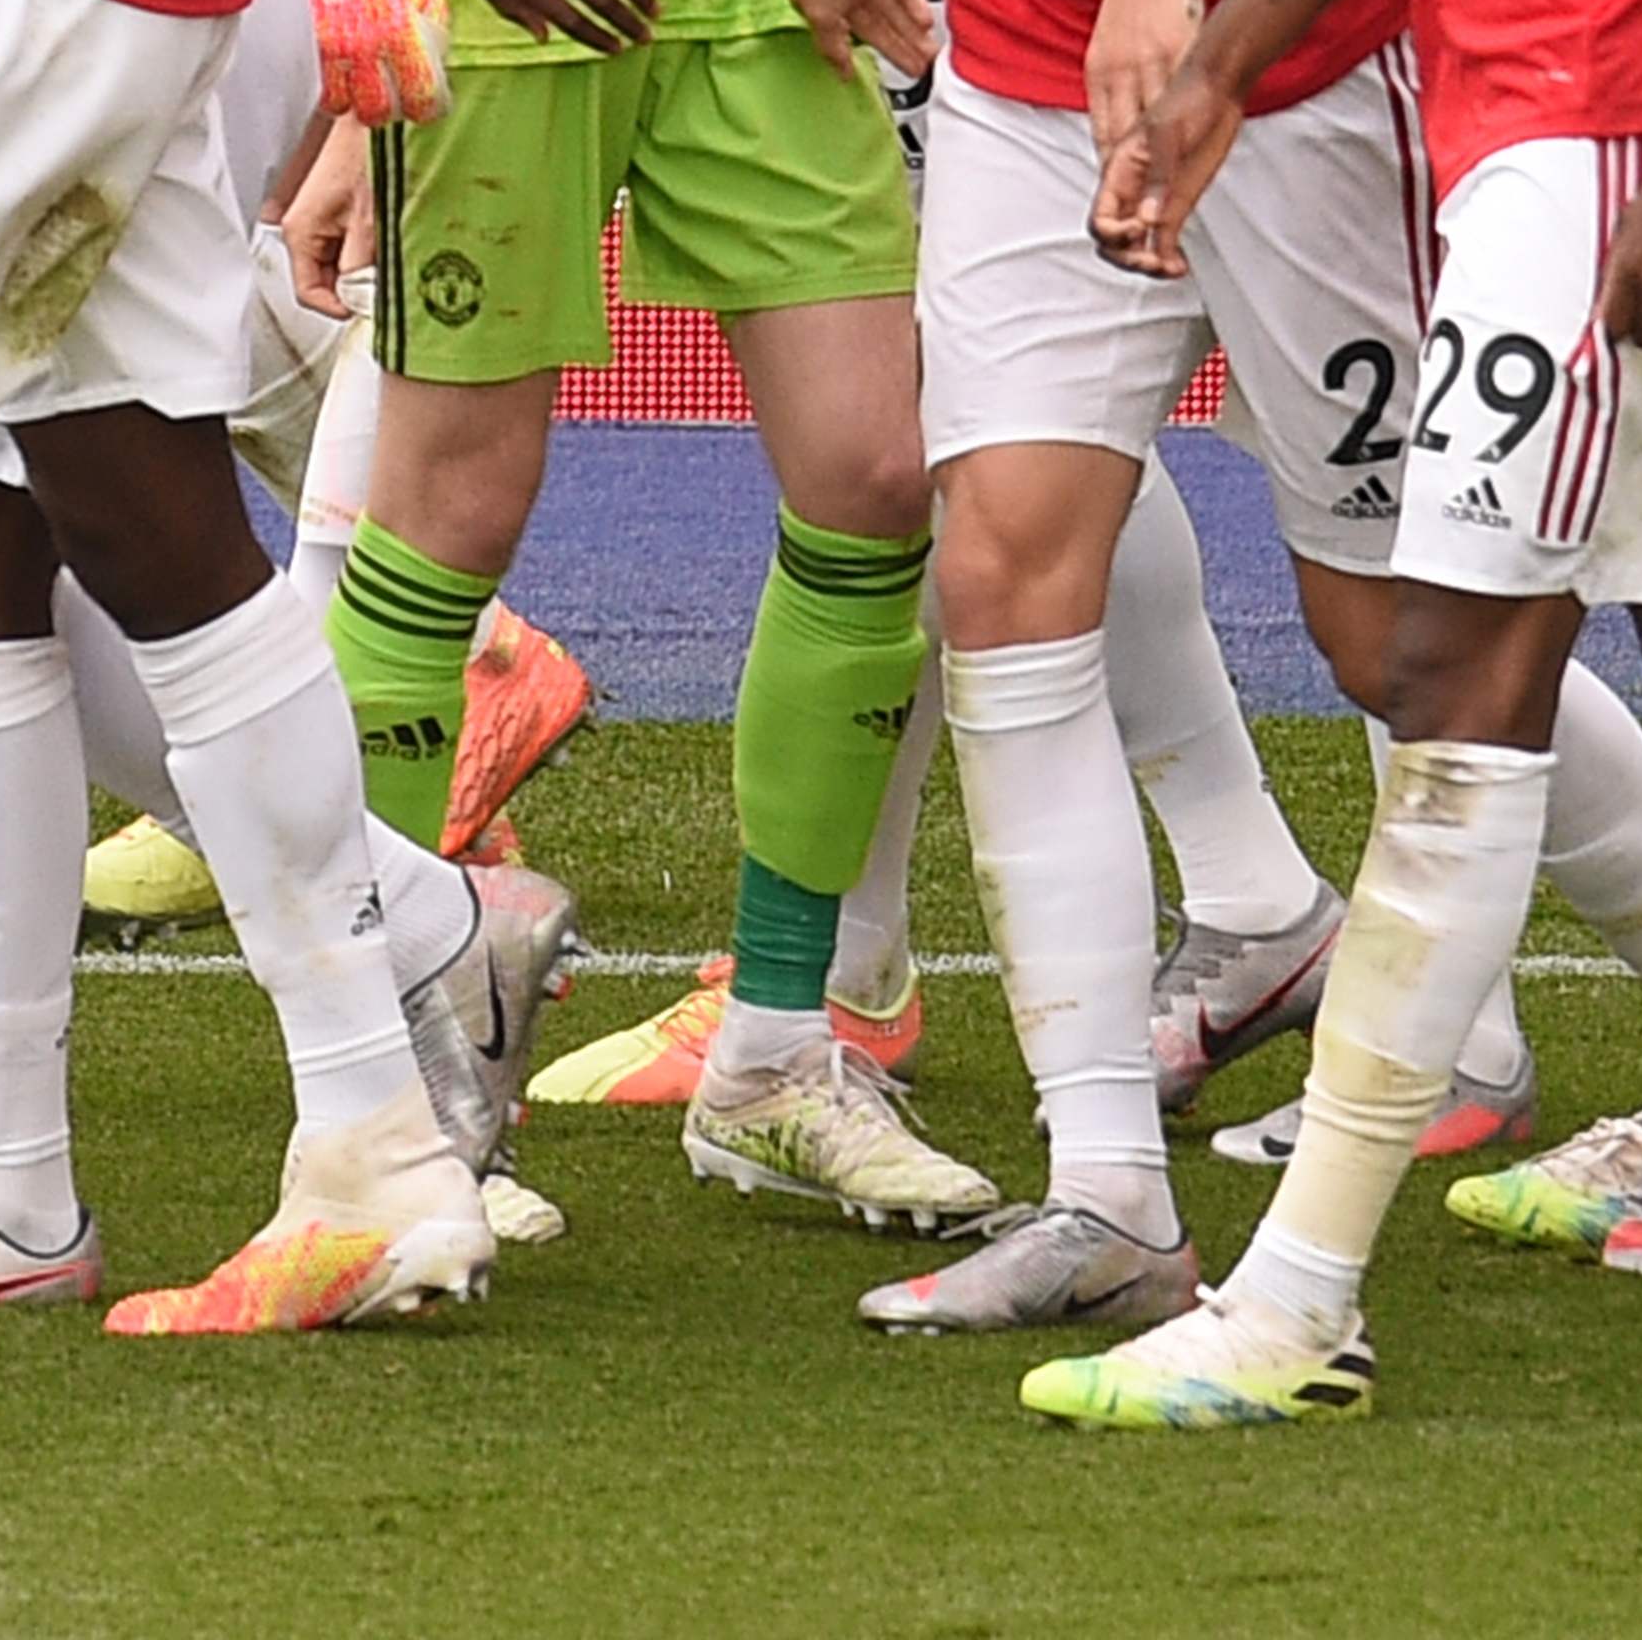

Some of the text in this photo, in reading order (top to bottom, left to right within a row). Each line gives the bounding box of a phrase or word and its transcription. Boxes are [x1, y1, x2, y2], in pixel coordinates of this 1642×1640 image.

[1323, 338, 1404, 466] 2
[1411, 317, 1556, 464] 29
[1442, 504, 1512, 530] adidas
